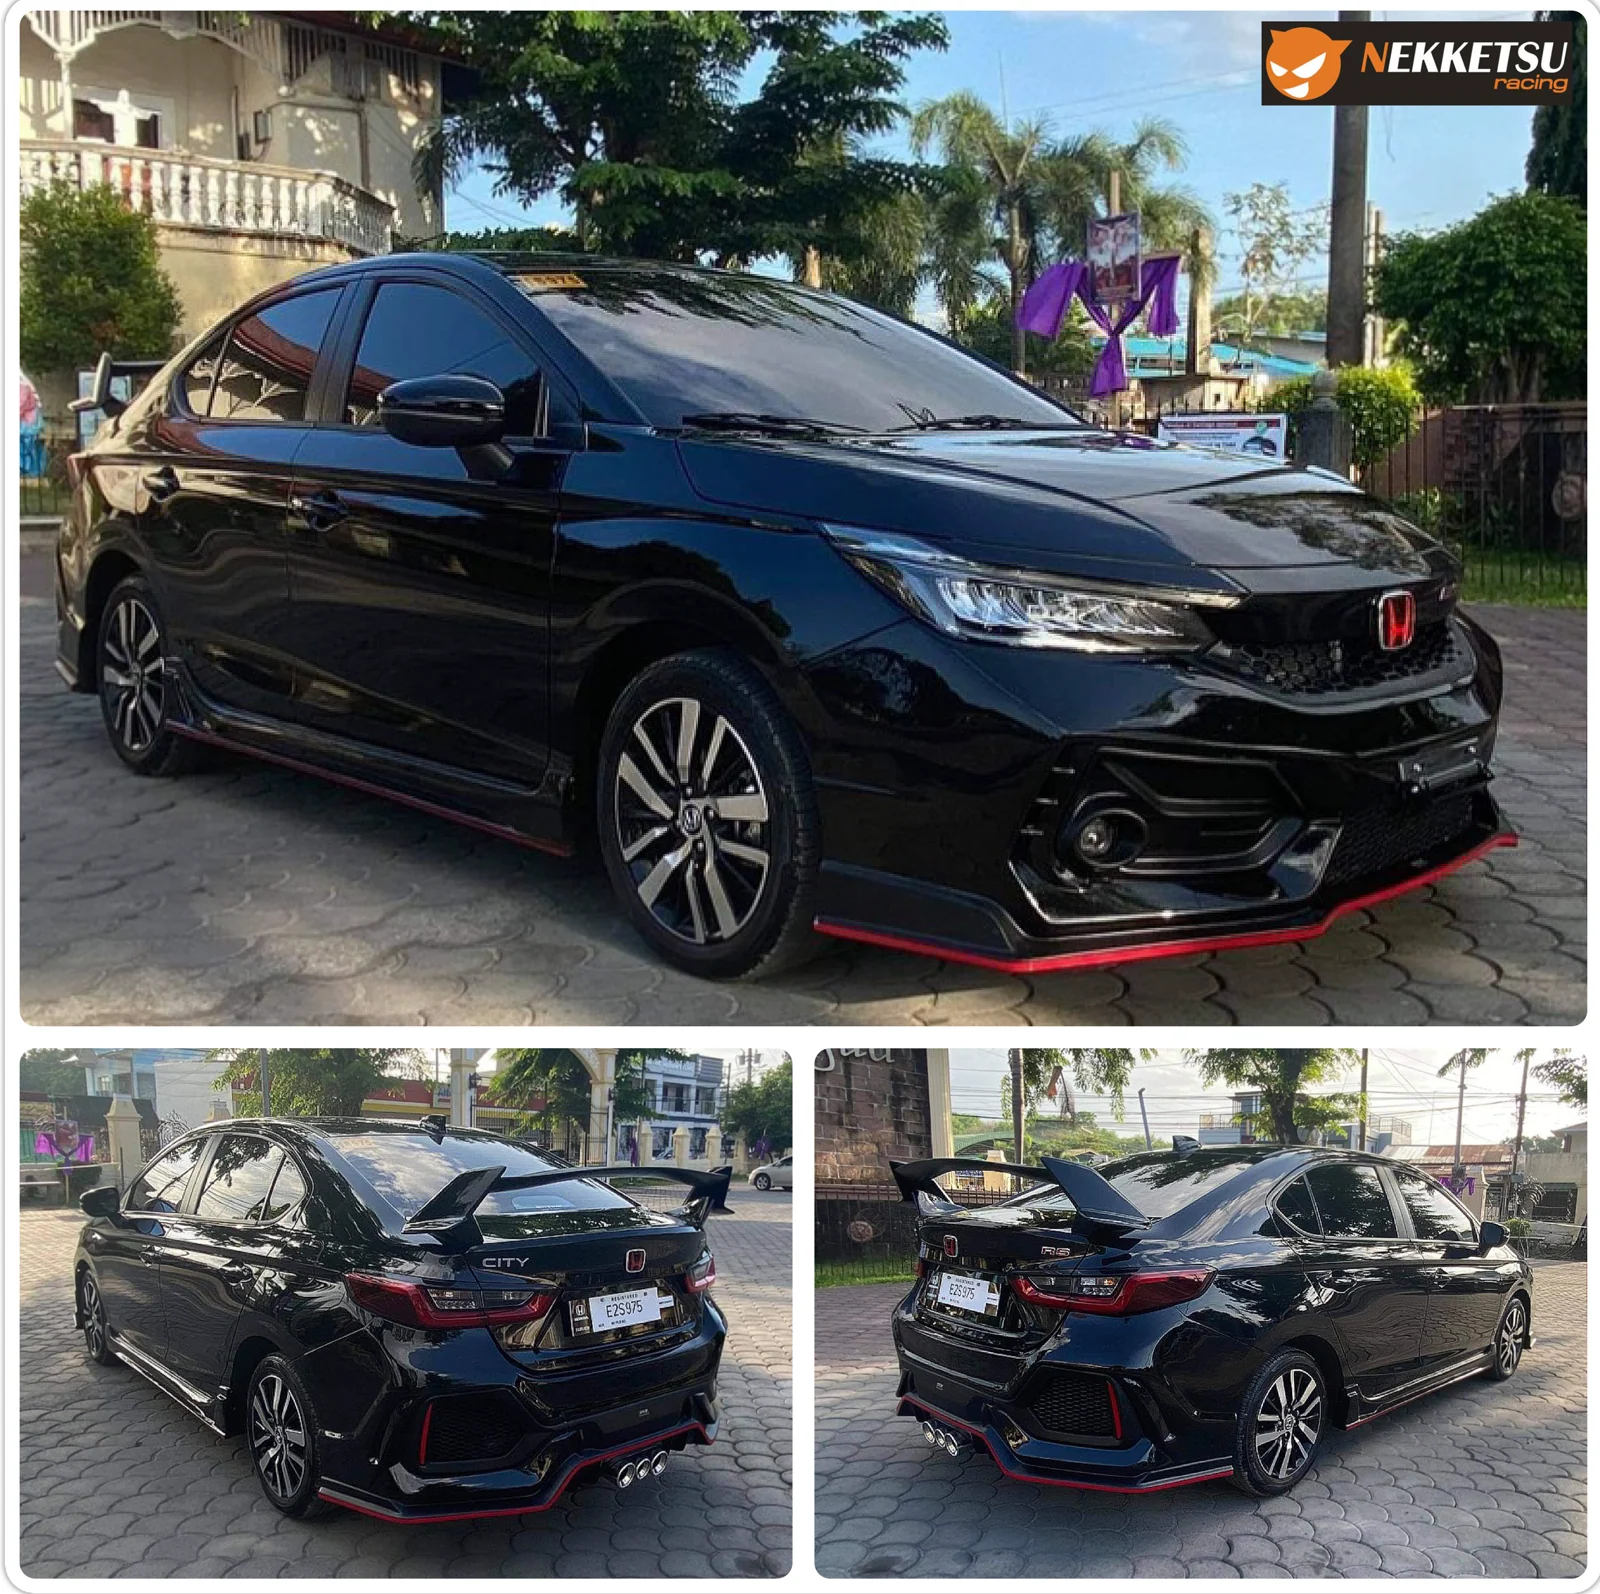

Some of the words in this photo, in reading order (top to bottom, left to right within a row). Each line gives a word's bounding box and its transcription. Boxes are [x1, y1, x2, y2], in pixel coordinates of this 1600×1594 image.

[1041, 1246, 1071, 1257] RS
[482, 1257, 530, 1268] CITY
[606, 1300, 643, 1318] E2S975
